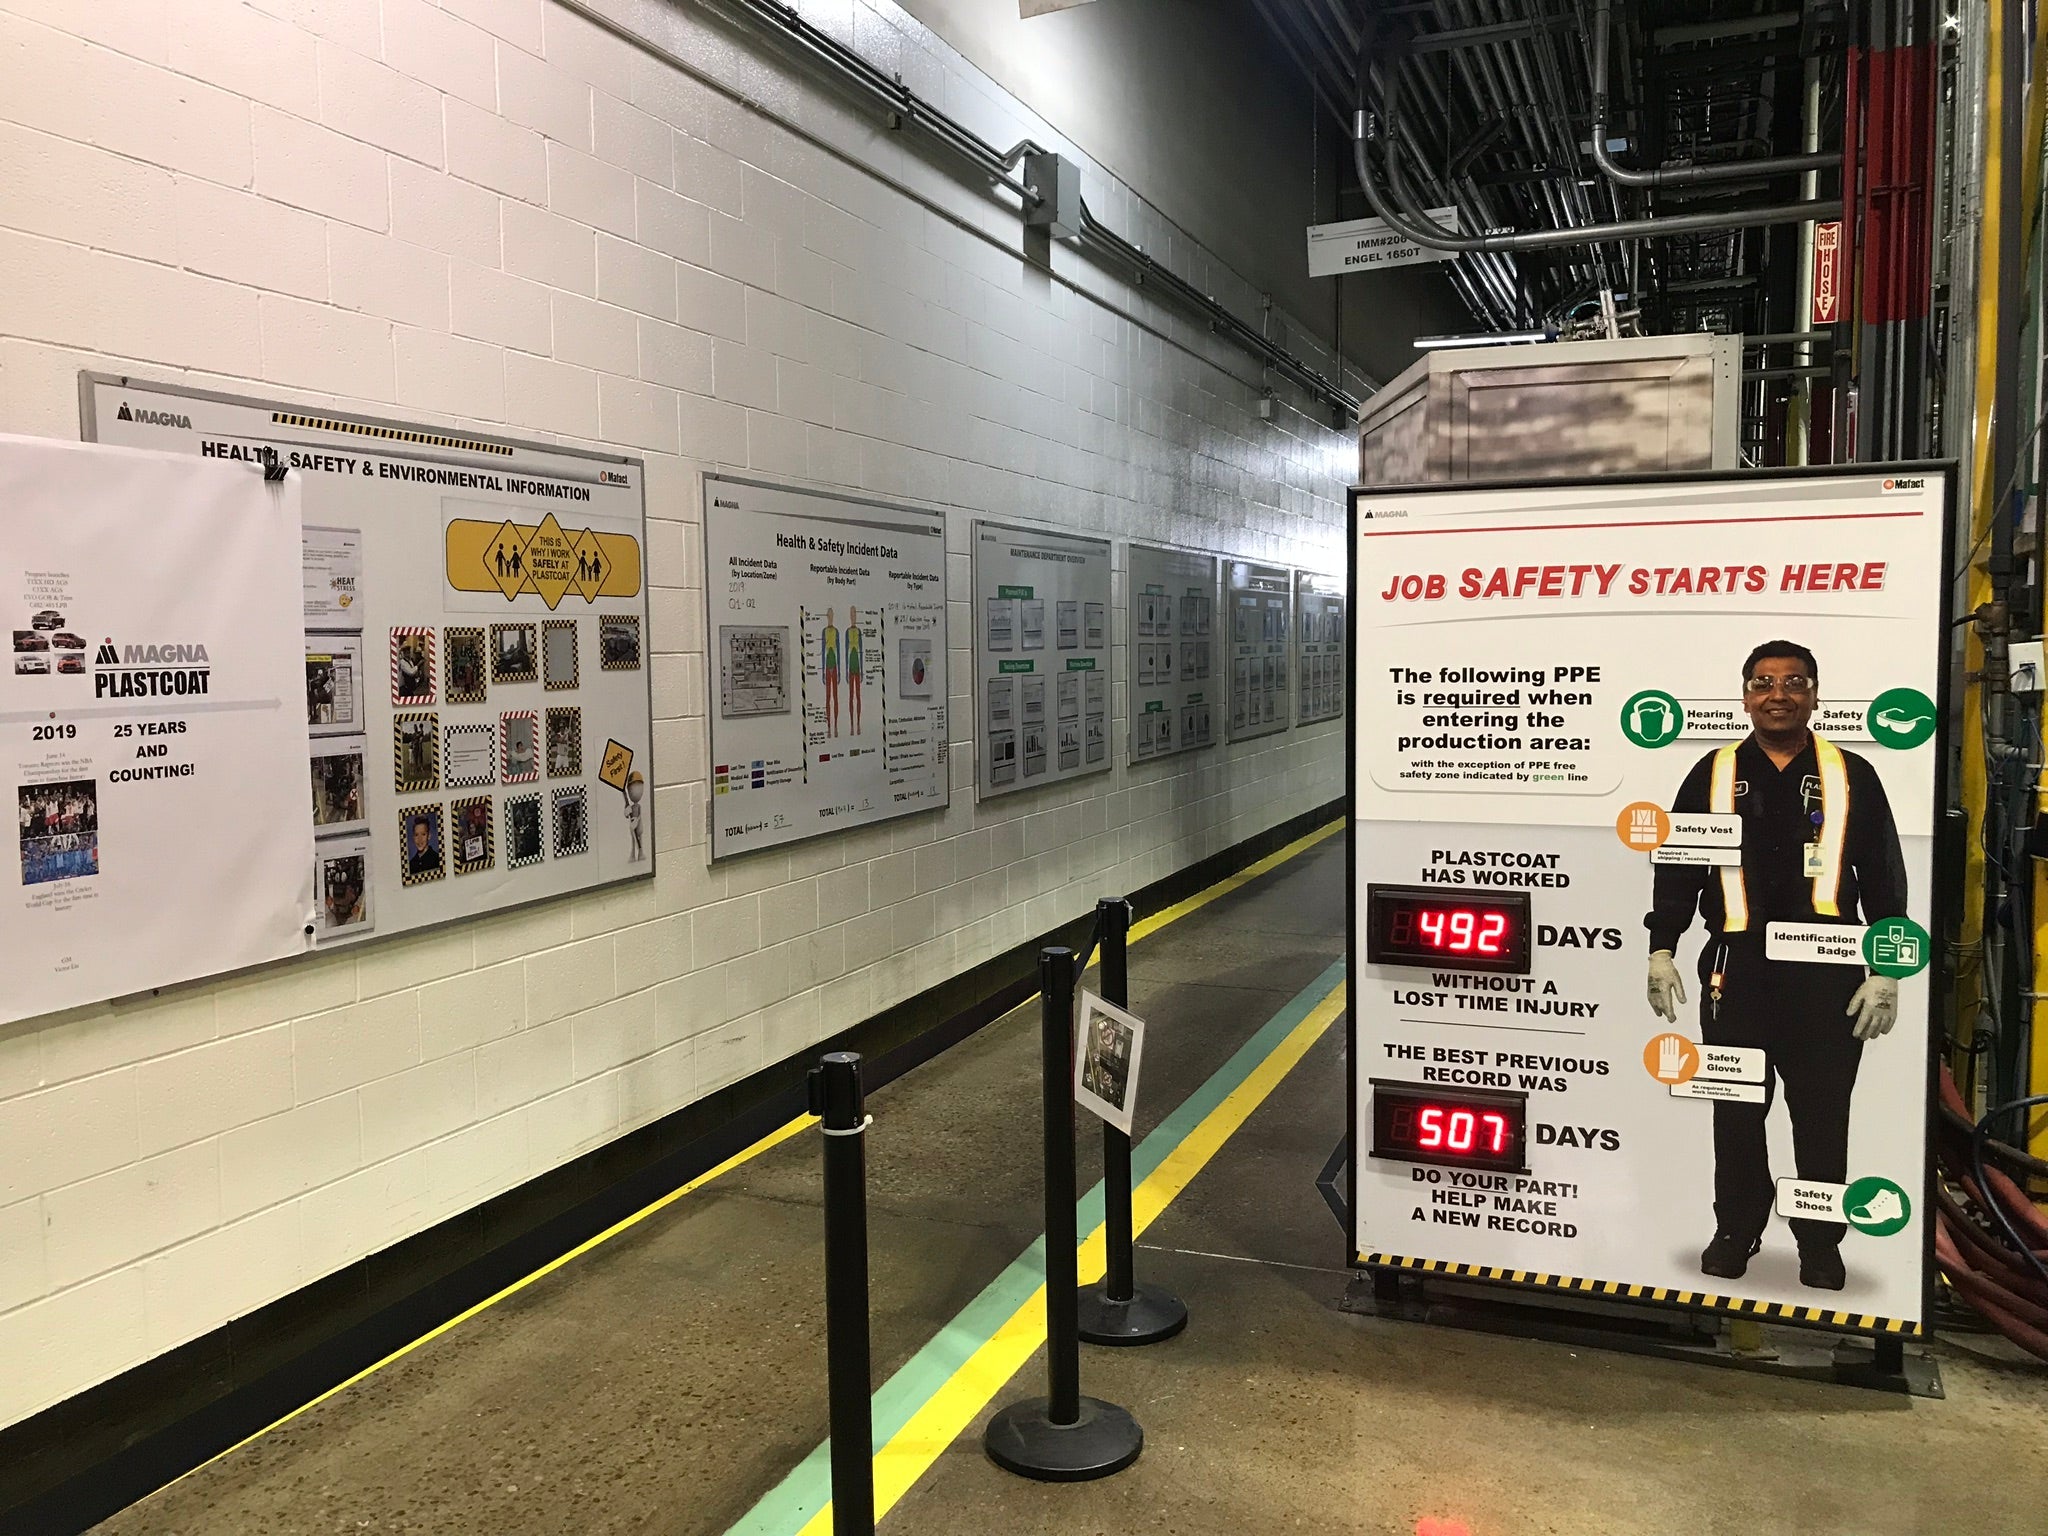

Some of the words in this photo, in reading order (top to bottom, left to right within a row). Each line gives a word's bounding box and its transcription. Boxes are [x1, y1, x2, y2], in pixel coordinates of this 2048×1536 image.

[1820, 232, 1835, 246] FIRE
[1344, 253, 1383, 265] ENGEL
[1386, 247, 1421, 260] 1650T
[1822, 249, 1831, 310] HOSE
[134, 408, 192, 429] MAGNA
[290, 452, 356, 476] SAFETY
[362, 461, 374, 477] &
[379, 463, 503, 492] ENVIRONMENTAL
[506, 478, 590, 502] INFORMATION
[1895, 478, 1925, 490] Mafact
[1375, 510, 1408, 519] MAGNA
[539, 536, 555, 547] THIS
[555, 538, 561, 547] IS
[776, 533, 806, 550] Health
[809, 538, 816, 550] &
[818, 538, 845, 557] Safety
[847, 542, 879, 557] Incident
[880, 545, 898, 559] Data
[530, 547, 546, 558] WHY
[550, 549, 570, 559] WORK
[1041, 552, 1066, 562] DEPARTMENT
[532, 558, 559, 570] SAFELY
[561, 560, 569, 570] AT
[729, 557, 737, 566] All
[738, 557, 762, 568] Incident
[764, 559, 777, 569] Data
[532, 570, 570, 581] PLASTCOAT
[731, 569, 740, 579] (by
[810, 564, 838, 576] Reportable
[838, 566, 858, 576] Incident
[859, 568, 870, 576] Data
[889, 571, 911, 581] Reportable
[912, 573, 928, 581] Incident
[929, 574, 939, 582] Data
[337, 577, 355, 586] HEAT
[835, 577, 846, 586] Body
[1381, 574, 1447, 601] JOB
[1458, 563, 1622, 599] SAFETY
[1628, 565, 1768, 595] STARTS
[1780, 562, 1887, 592] HERE
[123, 644, 209, 664] MAGNA
[1389, 668, 1432, 683] The
[1439, 667, 1545, 687] following
[1553, 667, 1600, 683] PPE
[95, 671, 210, 698] PLASTCOAT
[1397, 690, 1415, 705] is
[1423, 689, 1520, 708] required
[1528, 689, 1592, 705] when
[1422, 712, 1518, 731] entering
[1526, 712, 1565, 728] the
[1687, 710, 1733, 720] Hearing
[1823, 710, 1863, 721] Safety
[32, 724, 77, 741] 2019
[113, 724, 132, 738] 25
[137, 721, 187, 736] YEARS
[1687, 722, 1749, 731] Protection
[1813, 722, 1863, 731] Glasses
[1398, 733, 1521, 752] production
[1530, 737, 1591, 750] area:
[136, 744, 168, 758] AND
[1411, 760, 1434, 768] with
[1437, 760, 1455, 768] the
[1457, 761, 1510, 770] exception
[1514, 761, 1525, 769] of
[1528, 761, 1551, 770] PPE
[1553, 761, 1576, 770] free
[109, 764, 195, 783] COUNTING!
[1400, 770, 1432, 780] safety
[1463, 771, 1514, 780] indicated
[1516, 772, 1529, 782] by
[1532, 773, 1564, 782] green
[1567, 772, 1588, 781] line
[894, 793, 907, 801] TOTAL
[819, 808, 834, 817] TOTAL
[725, 825, 744, 837] TOTAL
[1675, 825, 1707, 835] Safety
[1709, 825, 1733, 834] Vest
[1431, 850, 1560, 868] PLASTCOAT
[1422, 868, 1465, 883] HAS
[1472, 870, 1570, 888] WORKED
[1420, 911, 1505, 952] 492
[1537, 924, 1622, 950] DAYS
[1774, 932, 1856, 944] Identification
[1817, 946, 1857, 957] Badge
[1432, 973, 1535, 993] WITHOUT
[1542, 981, 1558, 995] A
[1393, 990, 1448, 1007] LOST
[1455, 994, 1508, 1012] TIME
[1516, 999, 1599, 1018] INJURY
[1383, 1043, 1426, 1061] THE
[1432, 1048, 1488, 1066] BEST
[1495, 1052, 1610, 1076] PREVIOUS
[1707, 1053, 1741, 1064] Safety
[1706, 1064, 1742, 1074] Gloves
[1423, 1067, 1511, 1087] RECORD
[1518, 1074, 1568, 1092] WAS
[1700, 1084, 1723, 1092] required
[1419, 1109, 1504, 1151] 507
[1536, 1124, 1620, 1151] DAYS
[1412, 1168, 1441, 1184] DO
[1448, 1171, 1508, 1192] YOUR
[1515, 1178, 1578, 1199] PART!
[1794, 1188, 1833, 1201] Safety
[1431, 1189, 1487, 1208] HELP
[1494, 1196, 1556, 1216] MAKE
[1795, 1200, 1833, 1212] Shoes
[1411, 1207, 1426, 1221] A
[1432, 1209, 1480, 1228] NEW
[1487, 1215, 1577, 1238] RECORD
